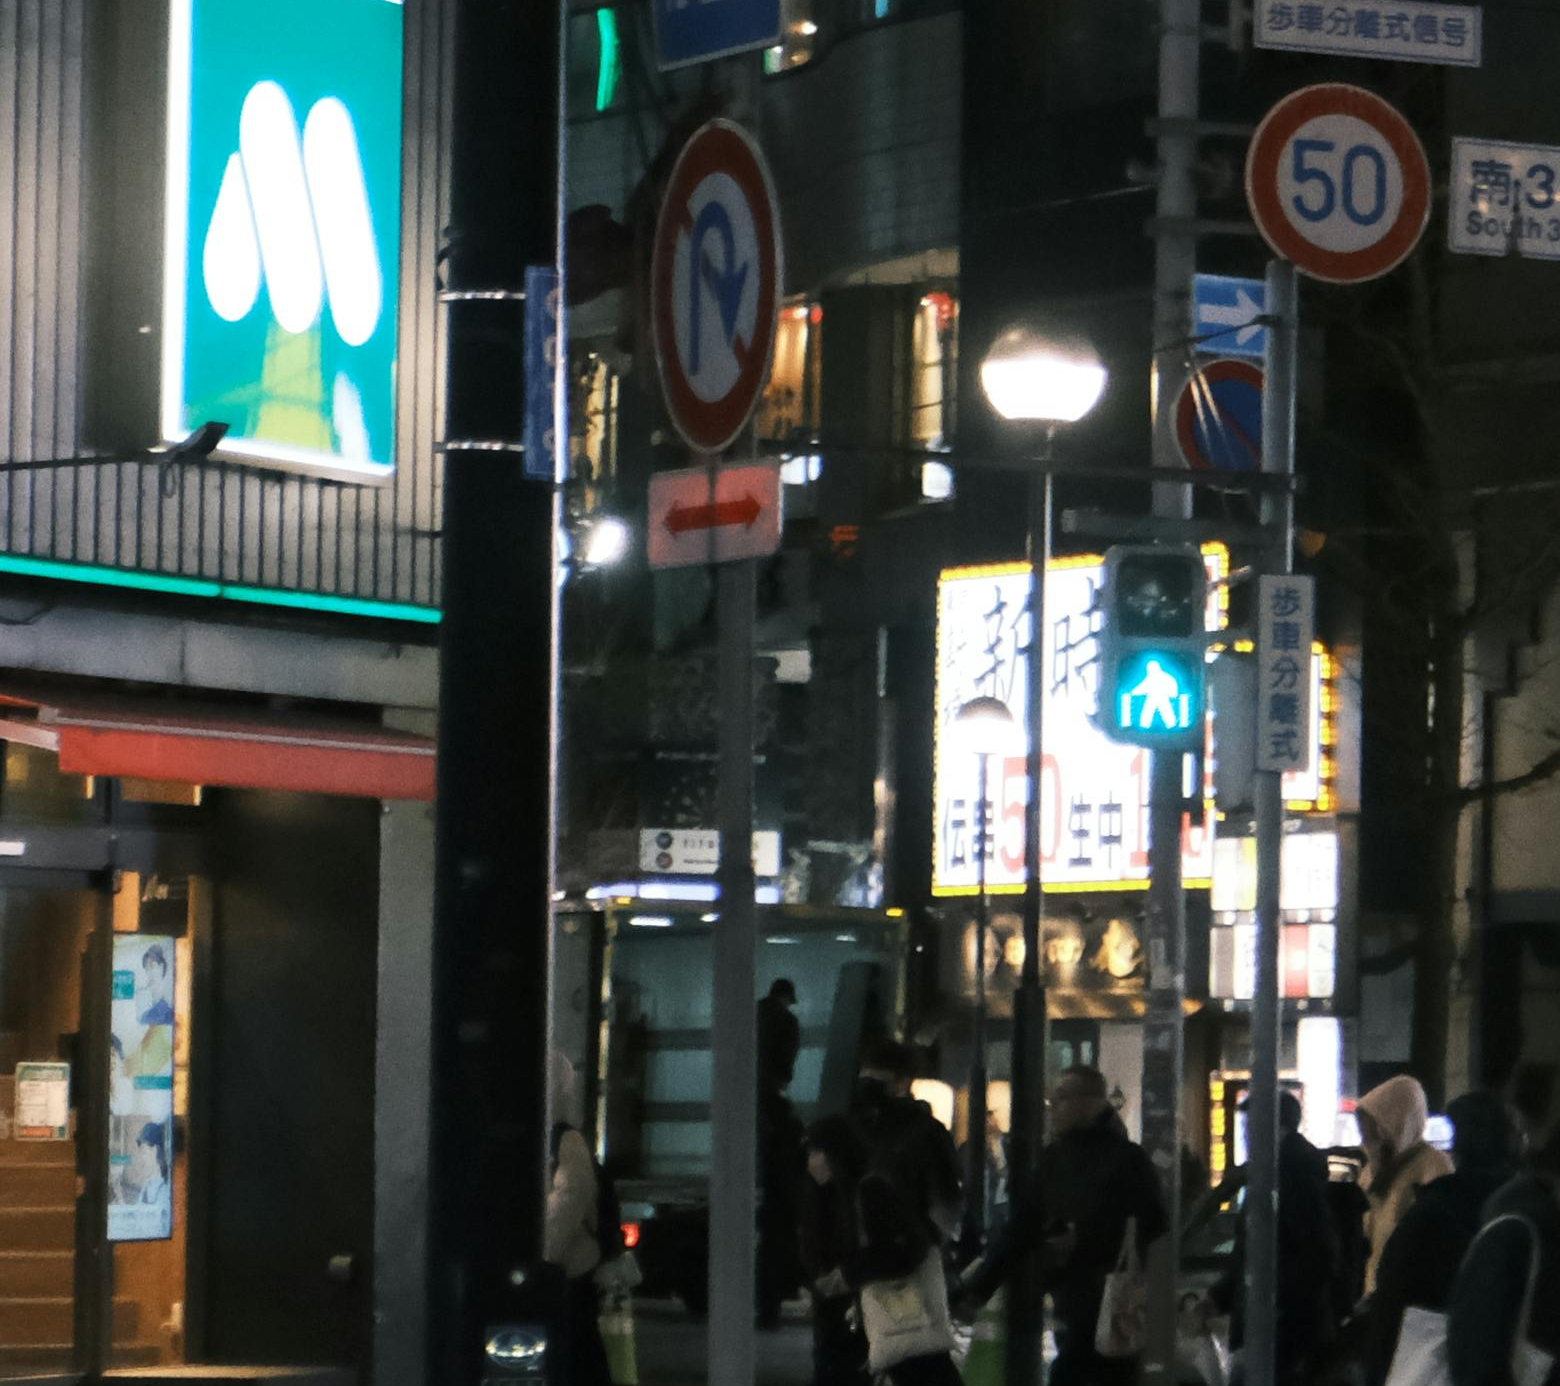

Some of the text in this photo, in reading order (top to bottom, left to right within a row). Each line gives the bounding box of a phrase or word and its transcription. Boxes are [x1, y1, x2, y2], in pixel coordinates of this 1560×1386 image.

[1267, 2, 1468, 48] 歩車分離式信号
[1292, 139, 1387, 227] 50
[1269, 586, 1300, 761] 歩車分離式
